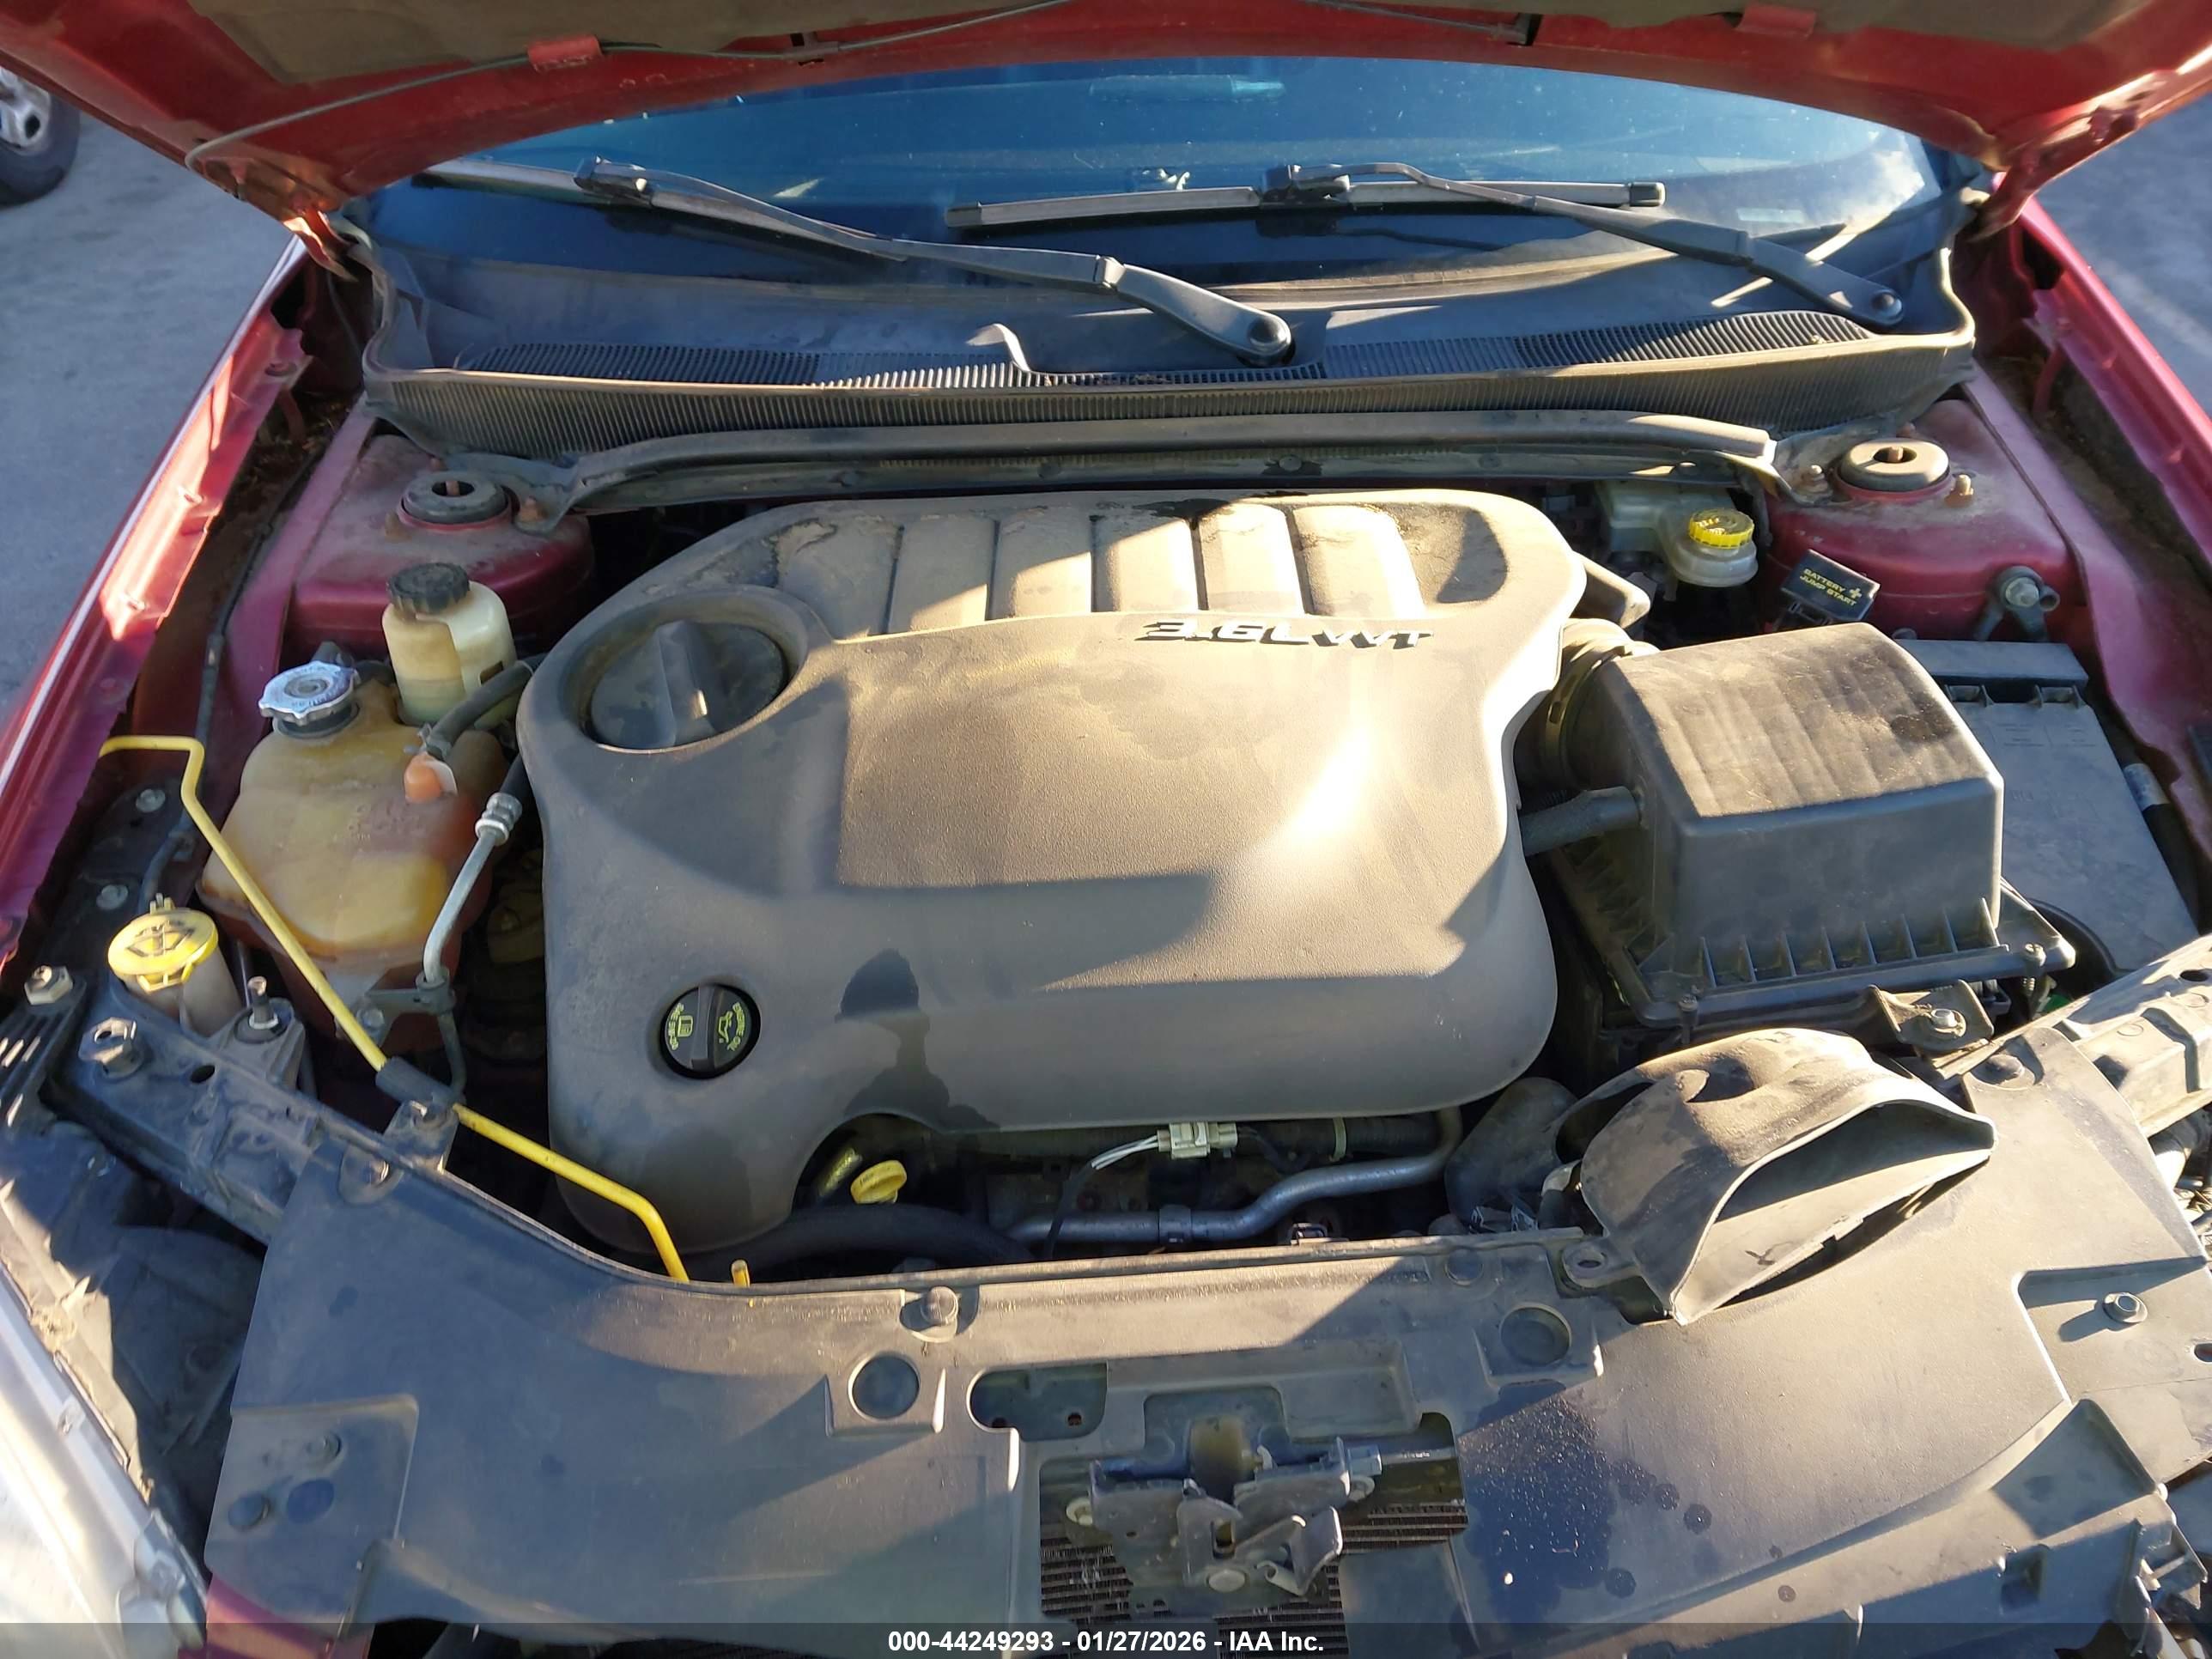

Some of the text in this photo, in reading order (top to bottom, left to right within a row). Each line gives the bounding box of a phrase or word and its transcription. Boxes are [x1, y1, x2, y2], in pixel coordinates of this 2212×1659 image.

[1800, 575, 1856, 605] JUMP START
[1804, 569, 1845, 592] BATTERY
[727, 1002, 744, 1051] ENGINE OIL
